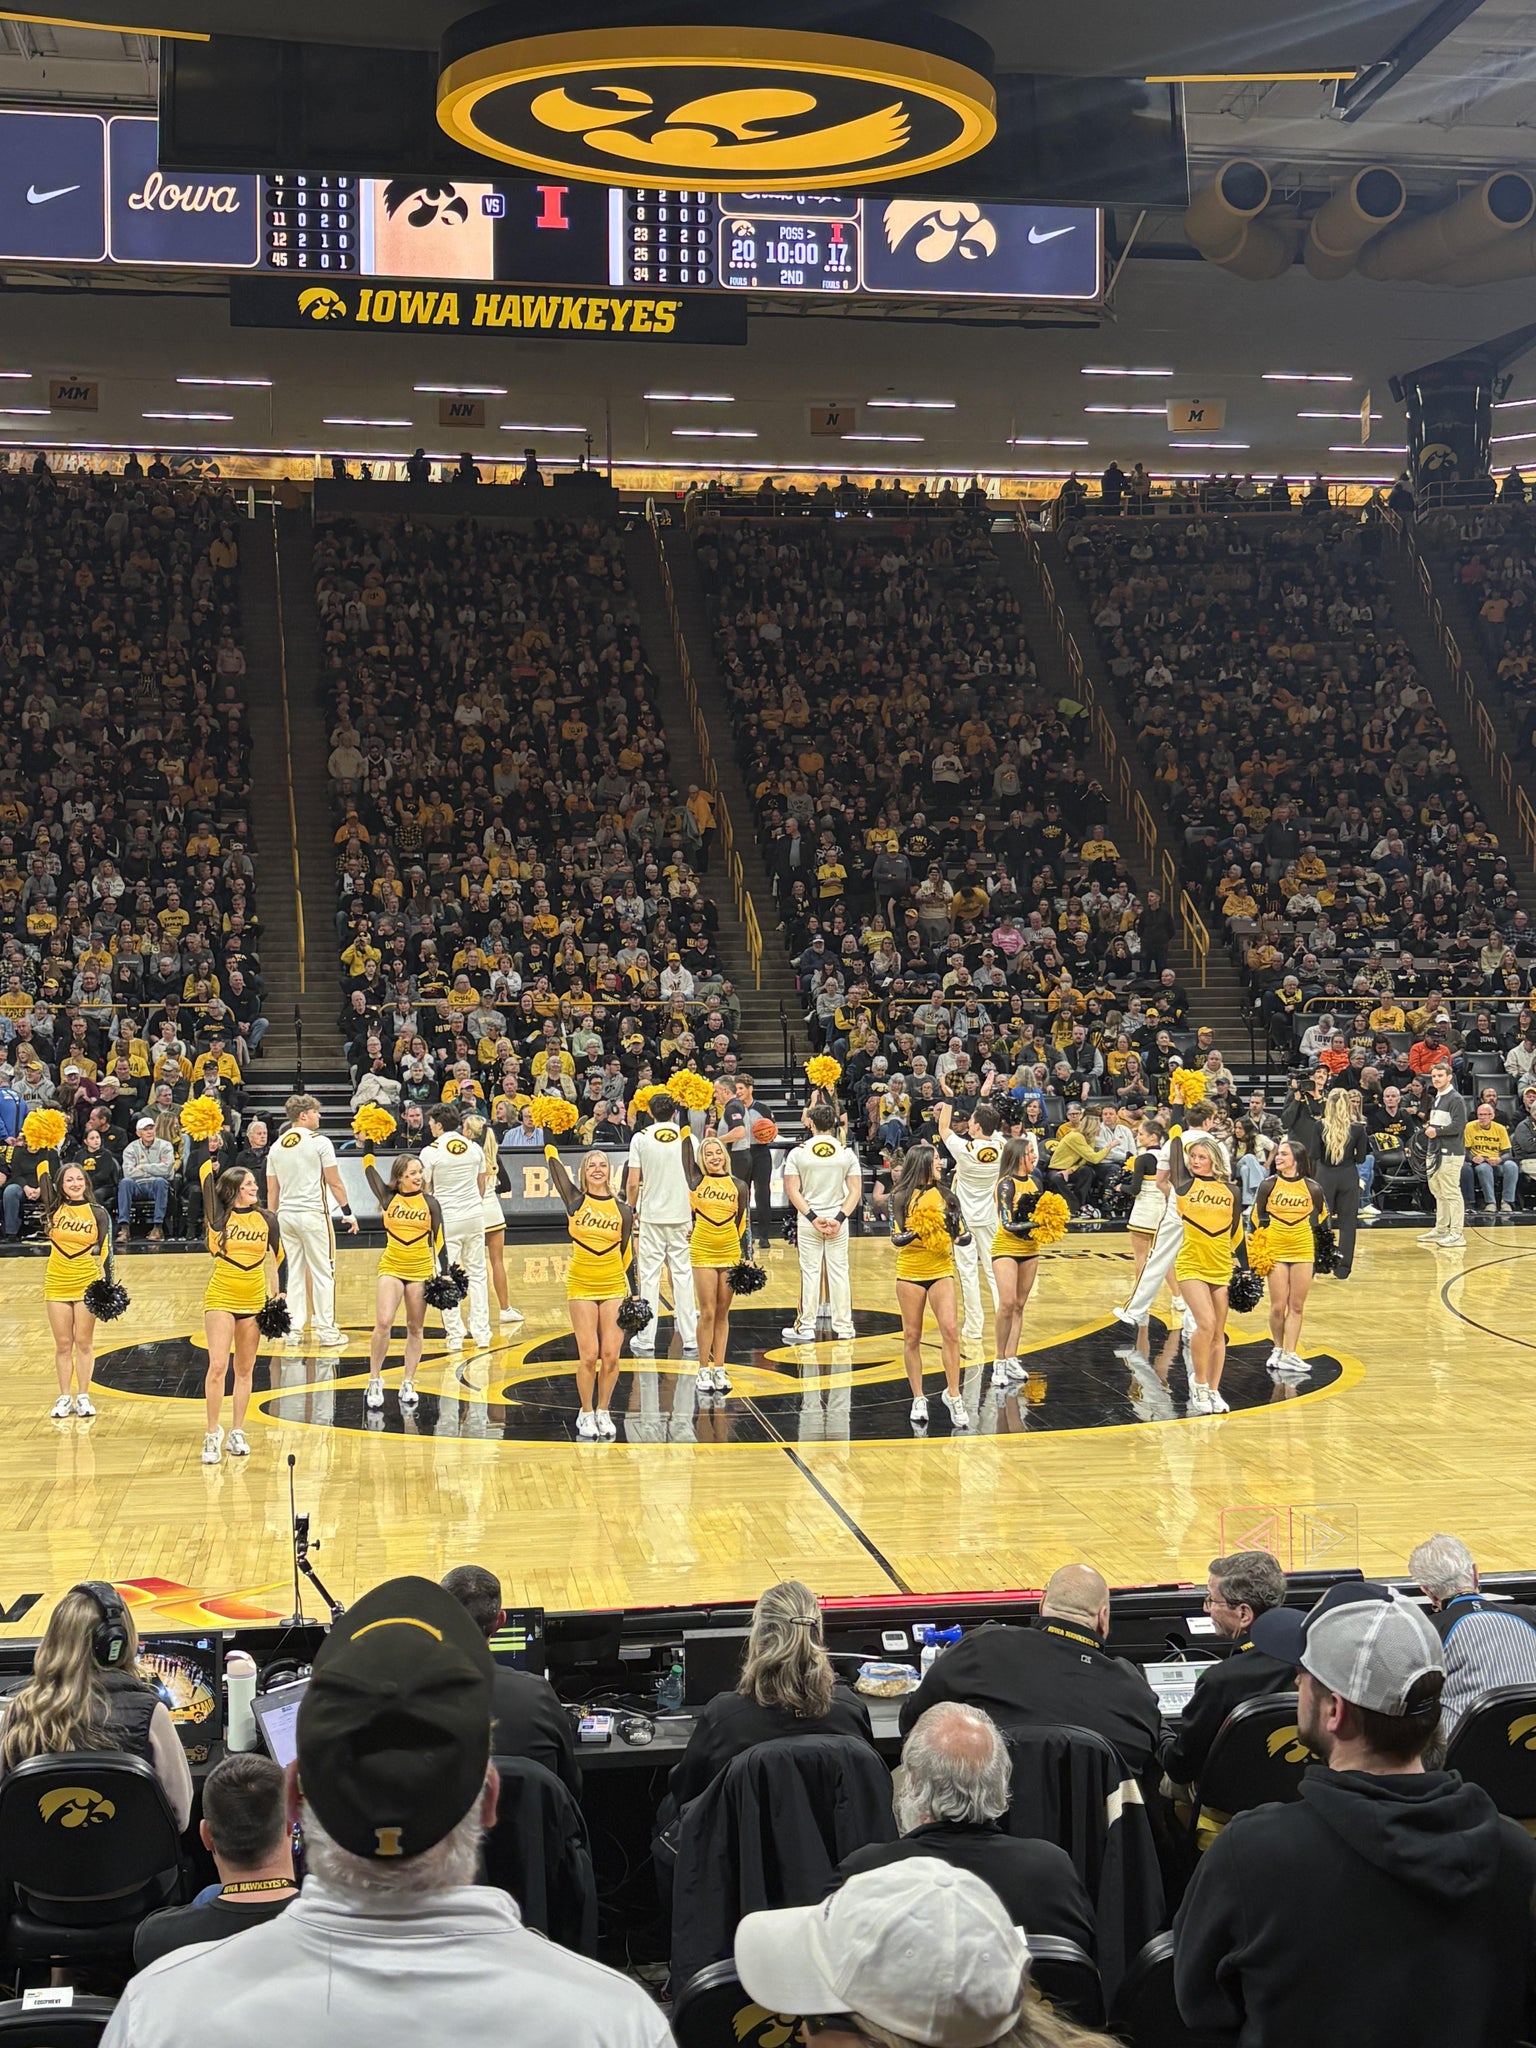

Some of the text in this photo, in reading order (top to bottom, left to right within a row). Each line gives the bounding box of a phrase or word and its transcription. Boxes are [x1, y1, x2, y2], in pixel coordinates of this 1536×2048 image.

[275, 175, 284, 186] 4
[128, 171, 240, 214] Iowa
[275, 191, 347, 208] 7 0 0 0
[659, 190, 667, 202] 2
[485, 198, 500, 213] VS
[537, 185, 569, 229] I
[273, 211, 347, 229] 11 0 2 0
[637, 207, 706, 223] 8 0 0 0
[272, 231, 347, 249] 12 2 1 0
[634, 227, 706, 244] 23 2 2 0
[779, 226, 804, 240] POSS
[271, 252, 348, 269] 45 2 0 1
[634, 247, 706, 264] 25 0 0 0
[732, 240, 848, 266] 20 10:00 17
[634, 267, 706, 284] 34 2 0 0
[730, 277, 748, 286] FOULS
[780, 270, 804, 285] 2ND
[822, 280, 840, 289] FOULS
[356, 289, 679, 333] IOWA HAWKEYES
[57, 386, 90, 400] MM
[449, 403, 475, 417] NN
[1187, 409, 1205, 423] M
[826, 413, 840, 426] N
[697, 1185, 736, 1202] Iowa
[1190, 1190, 1232, 1207] Iowa
[1271, 1193, 1309, 1207] Iowa
[388, 1204, 427, 1221] Iowa
[52, 1215, 94, 1234] Iowa
[575, 1212, 620, 1231] Iowa
